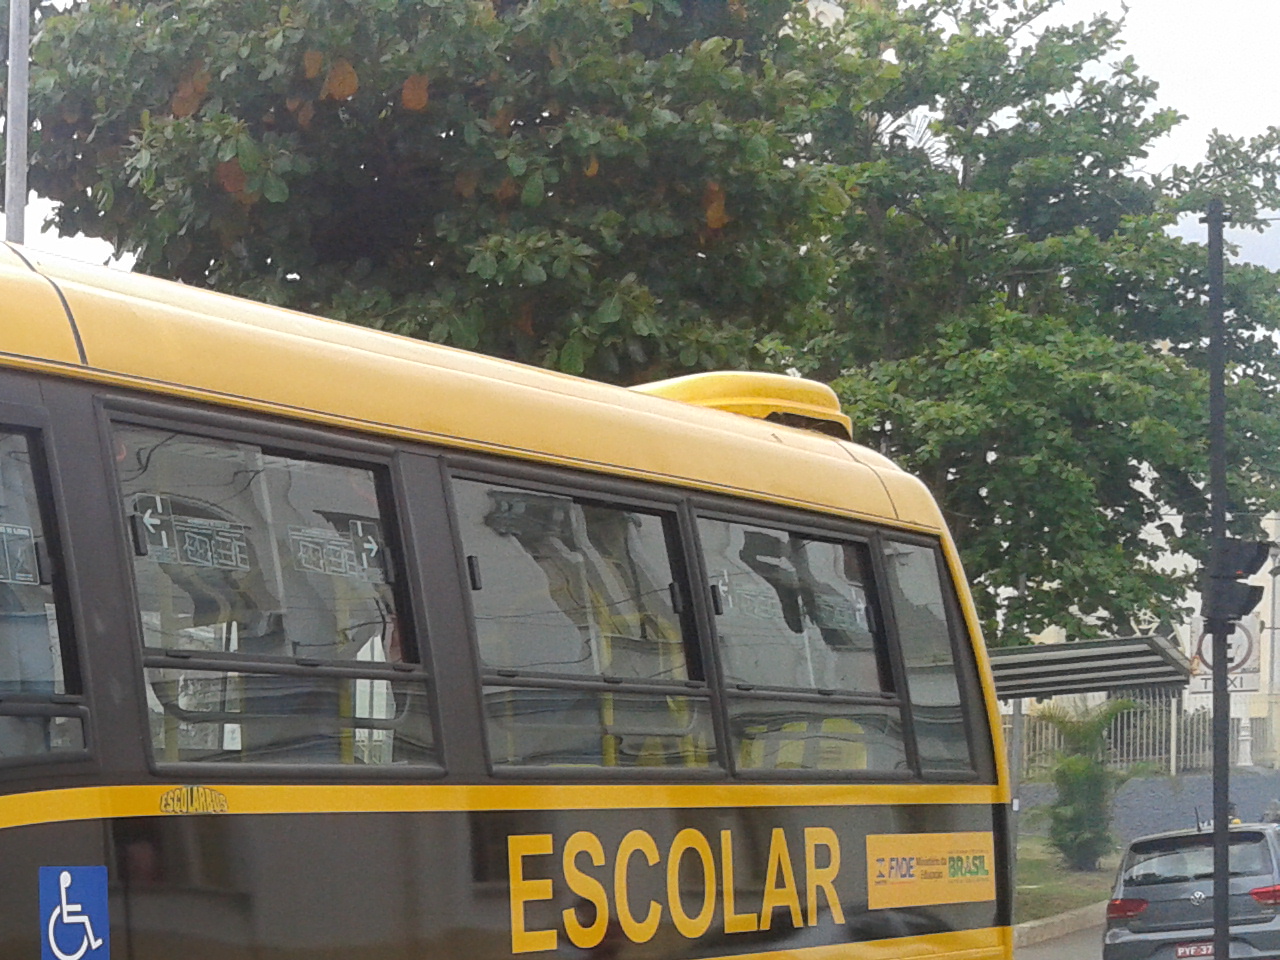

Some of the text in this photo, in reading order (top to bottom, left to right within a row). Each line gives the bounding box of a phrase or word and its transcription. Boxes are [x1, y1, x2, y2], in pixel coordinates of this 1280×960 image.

[1201, 676, 1244, 690] TXI
[948, 855, 989, 878] BRASIL
[507, 827, 846, 954] ESCOLAR
